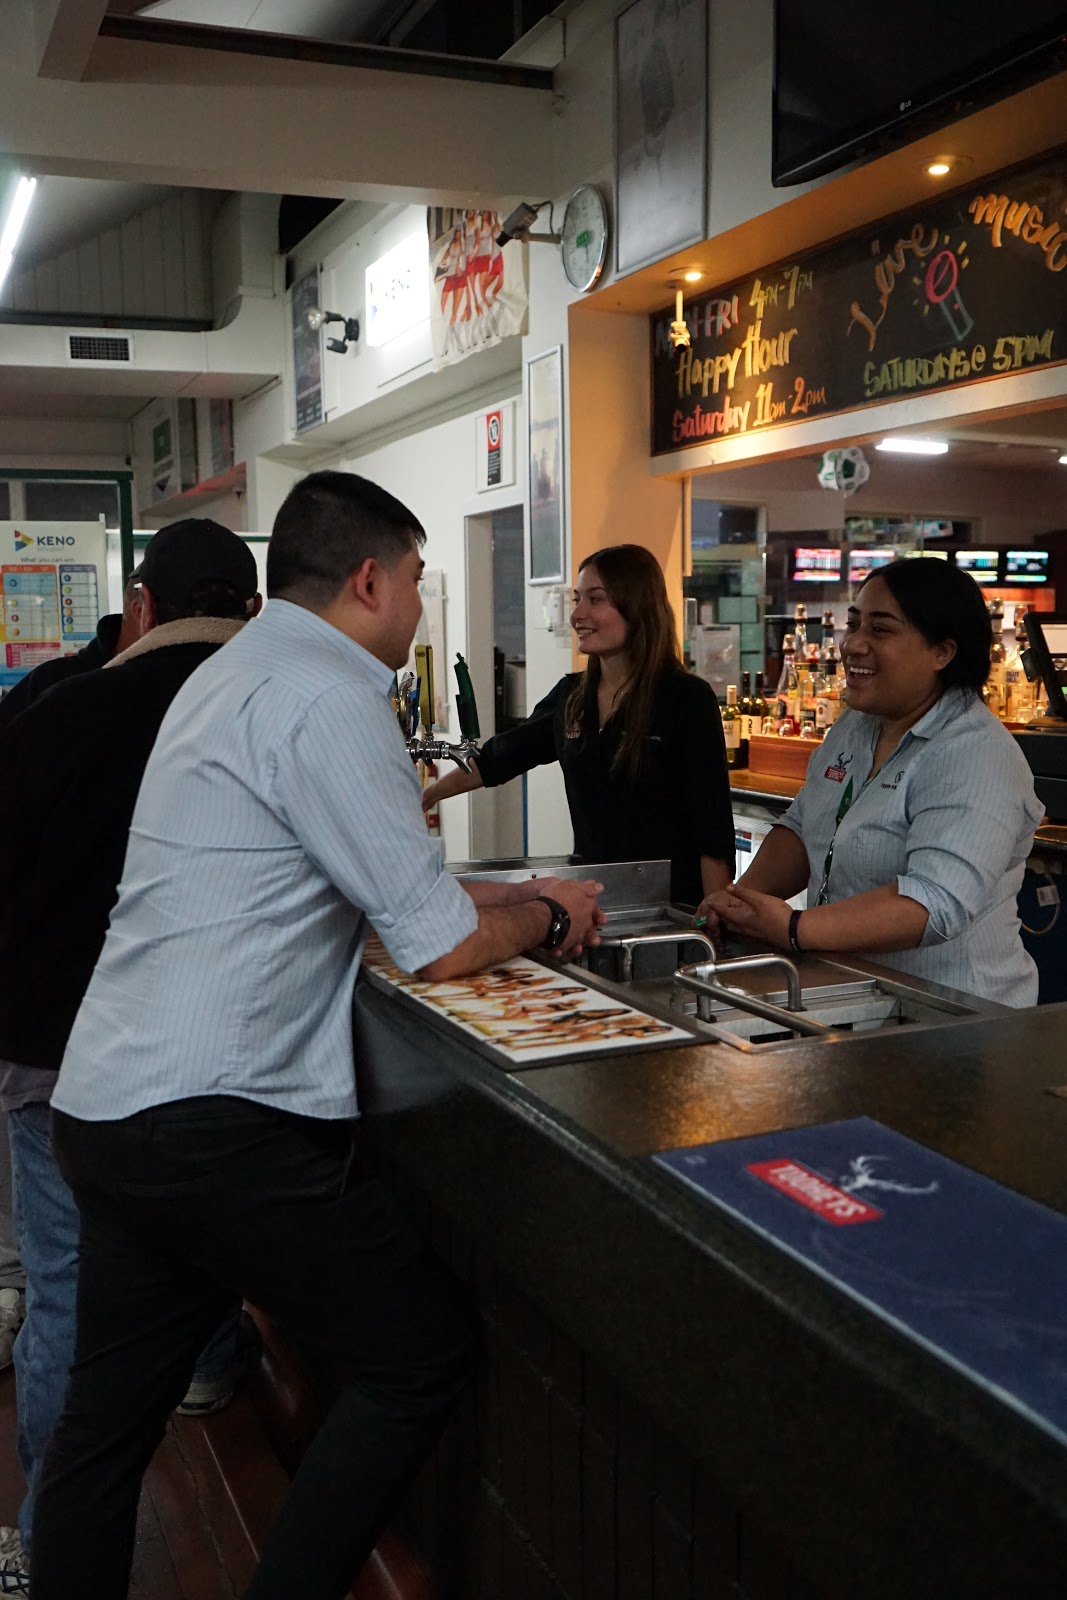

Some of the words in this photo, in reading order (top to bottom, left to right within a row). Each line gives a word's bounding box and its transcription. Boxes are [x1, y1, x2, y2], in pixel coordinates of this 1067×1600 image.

[675, 346, 742, 399] Happy
[741, 319, 799, 378] Hour
[672, 394, 751, 443] Saturday
[37, 536, 75, 546] KENO
